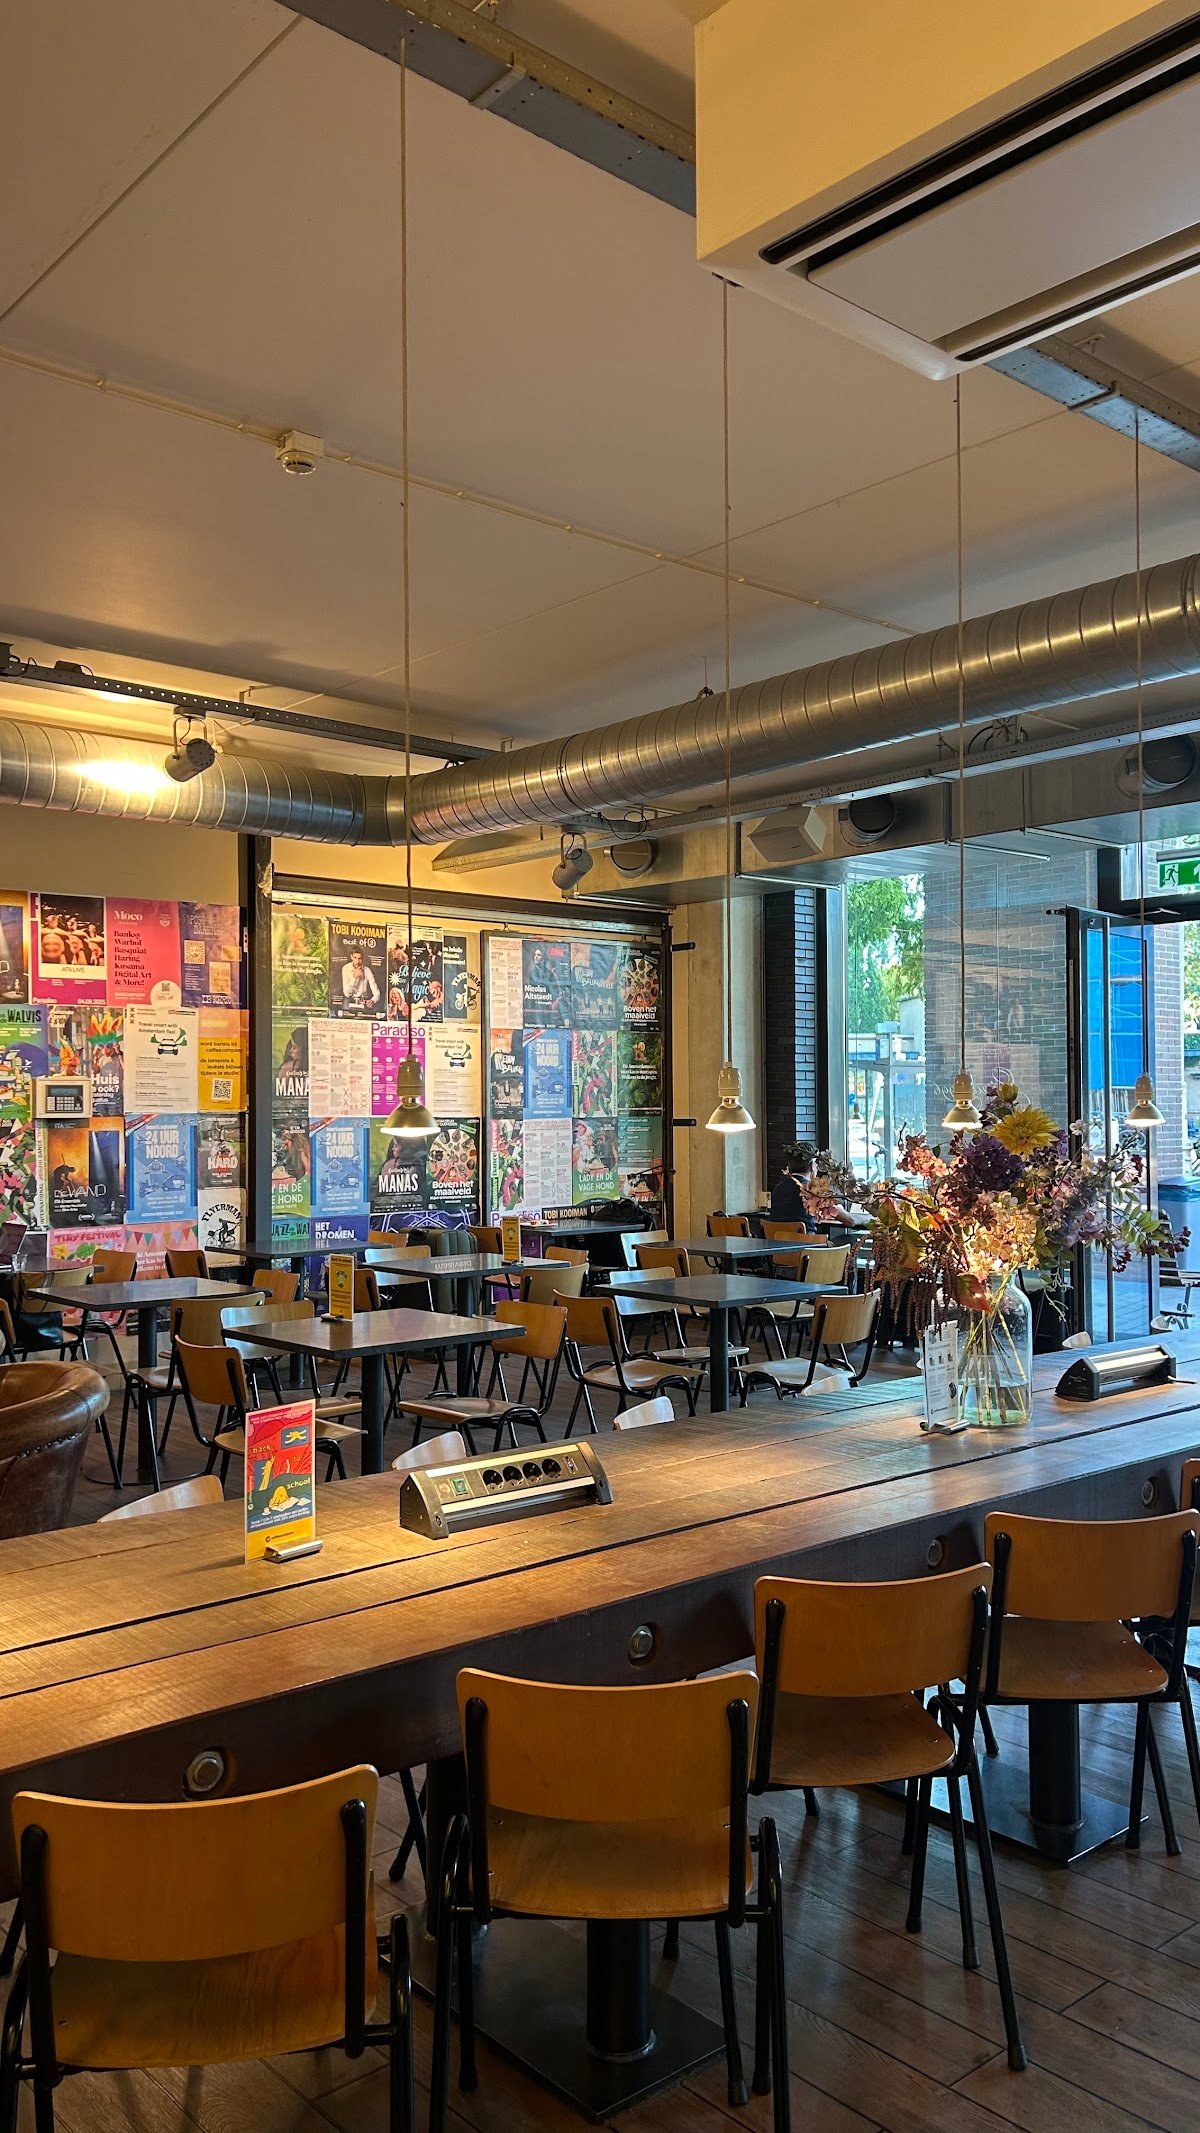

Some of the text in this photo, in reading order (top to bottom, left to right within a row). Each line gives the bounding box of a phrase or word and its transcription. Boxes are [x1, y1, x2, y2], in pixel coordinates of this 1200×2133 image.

[114, 910, 143, 920] Moco
[114, 930, 140, 939] Banksy
[331, 924, 350, 935] TOBI
[350, 926, 386, 938] KOOIMAN
[114, 970, 138, 978] Digital
[398, 964, 431, 978] Blieve
[8, 1009, 41, 1023] WALVIS
[372, 1023, 425, 1036] Paradso
[91, 1074, 119, 1084] Huis
[276, 1078, 309, 1096] MANA
[145, 1130, 179, 1144] 24 UUR
[326, 1132, 354, 1145] 24 UUR
[146, 1144, 179, 1158] NOORD
[326, 1145, 354, 1158] NOORD
[208, 1157, 238, 1169] HARD
[580, 1174, 594, 1182] LADY
[279, 1183, 302, 1192] EN DE
[378, 1174, 418, 1193] MANAS
[460, 1180, 474, 1188] het
[579, 1182, 614, 1191] VAGE HOND
[434, 1187, 471, 1196] maaiveld
[278, 1194, 303, 1204] HOND
[544, 1208, 588, 1219] TOBI KOOIMAN
[272, 1224, 289, 1237] JAZZ
[315, 1222, 330, 1231] HET
[81, 1232, 121, 1241] FESTIVAL
[316, 1230, 354, 1239] DROMEN
[253, 1444, 271, 1453] back
[287, 1477, 311, 1489] school
